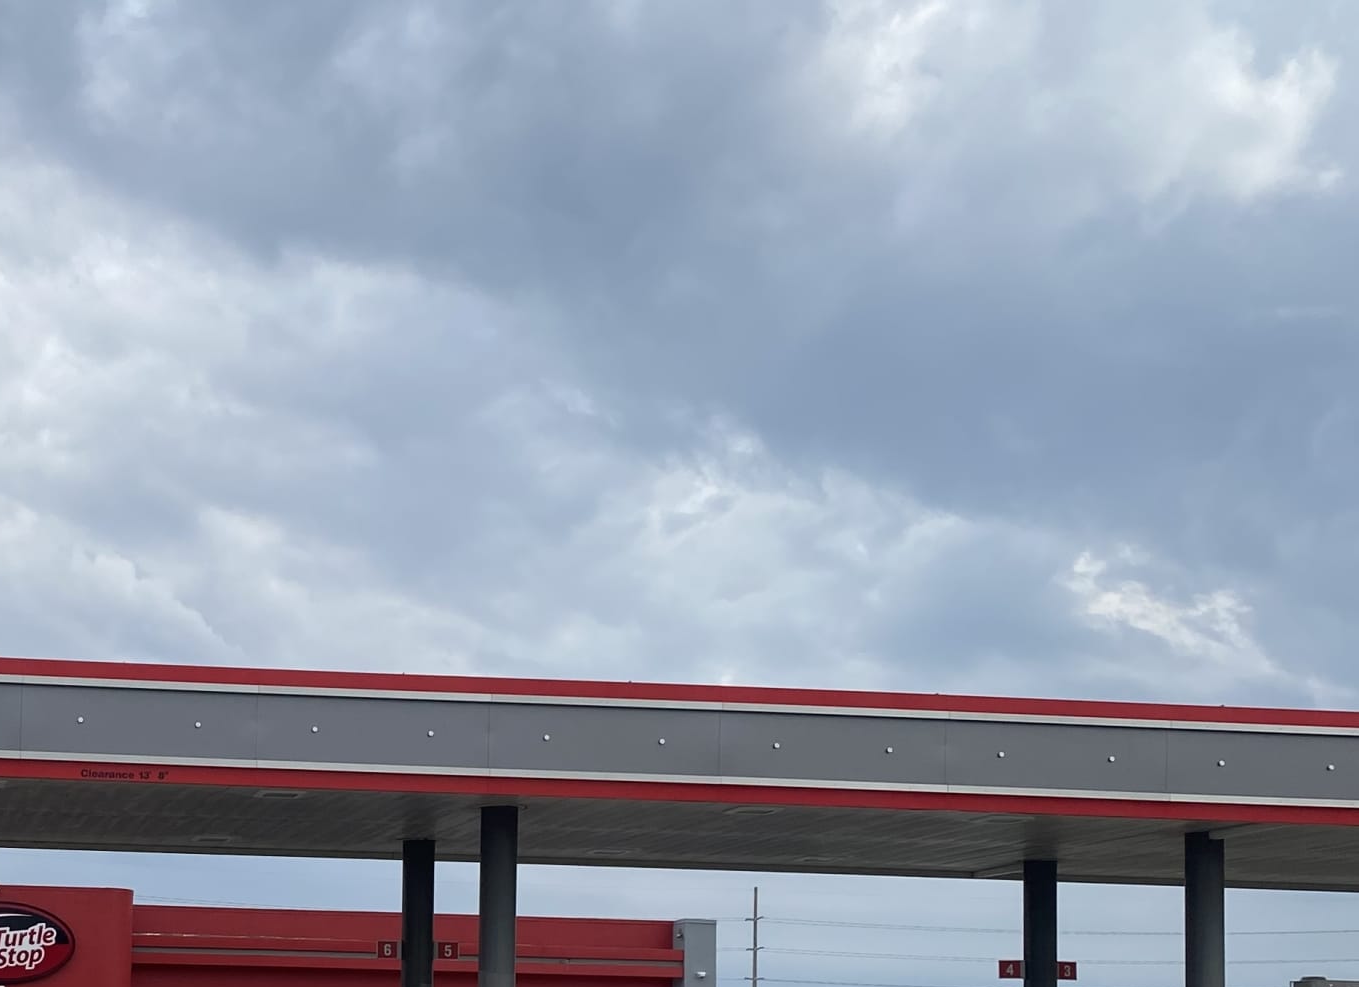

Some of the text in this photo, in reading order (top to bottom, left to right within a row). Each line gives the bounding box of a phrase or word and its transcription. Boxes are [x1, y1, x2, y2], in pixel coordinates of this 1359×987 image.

[81, 769, 135, 779] Clearance
[384, 944, 392, 956] 6
[444, 945, 452, 957] 5
[1006, 964, 1014, 976] 4
[1064, 965, 1071, 977] 3
